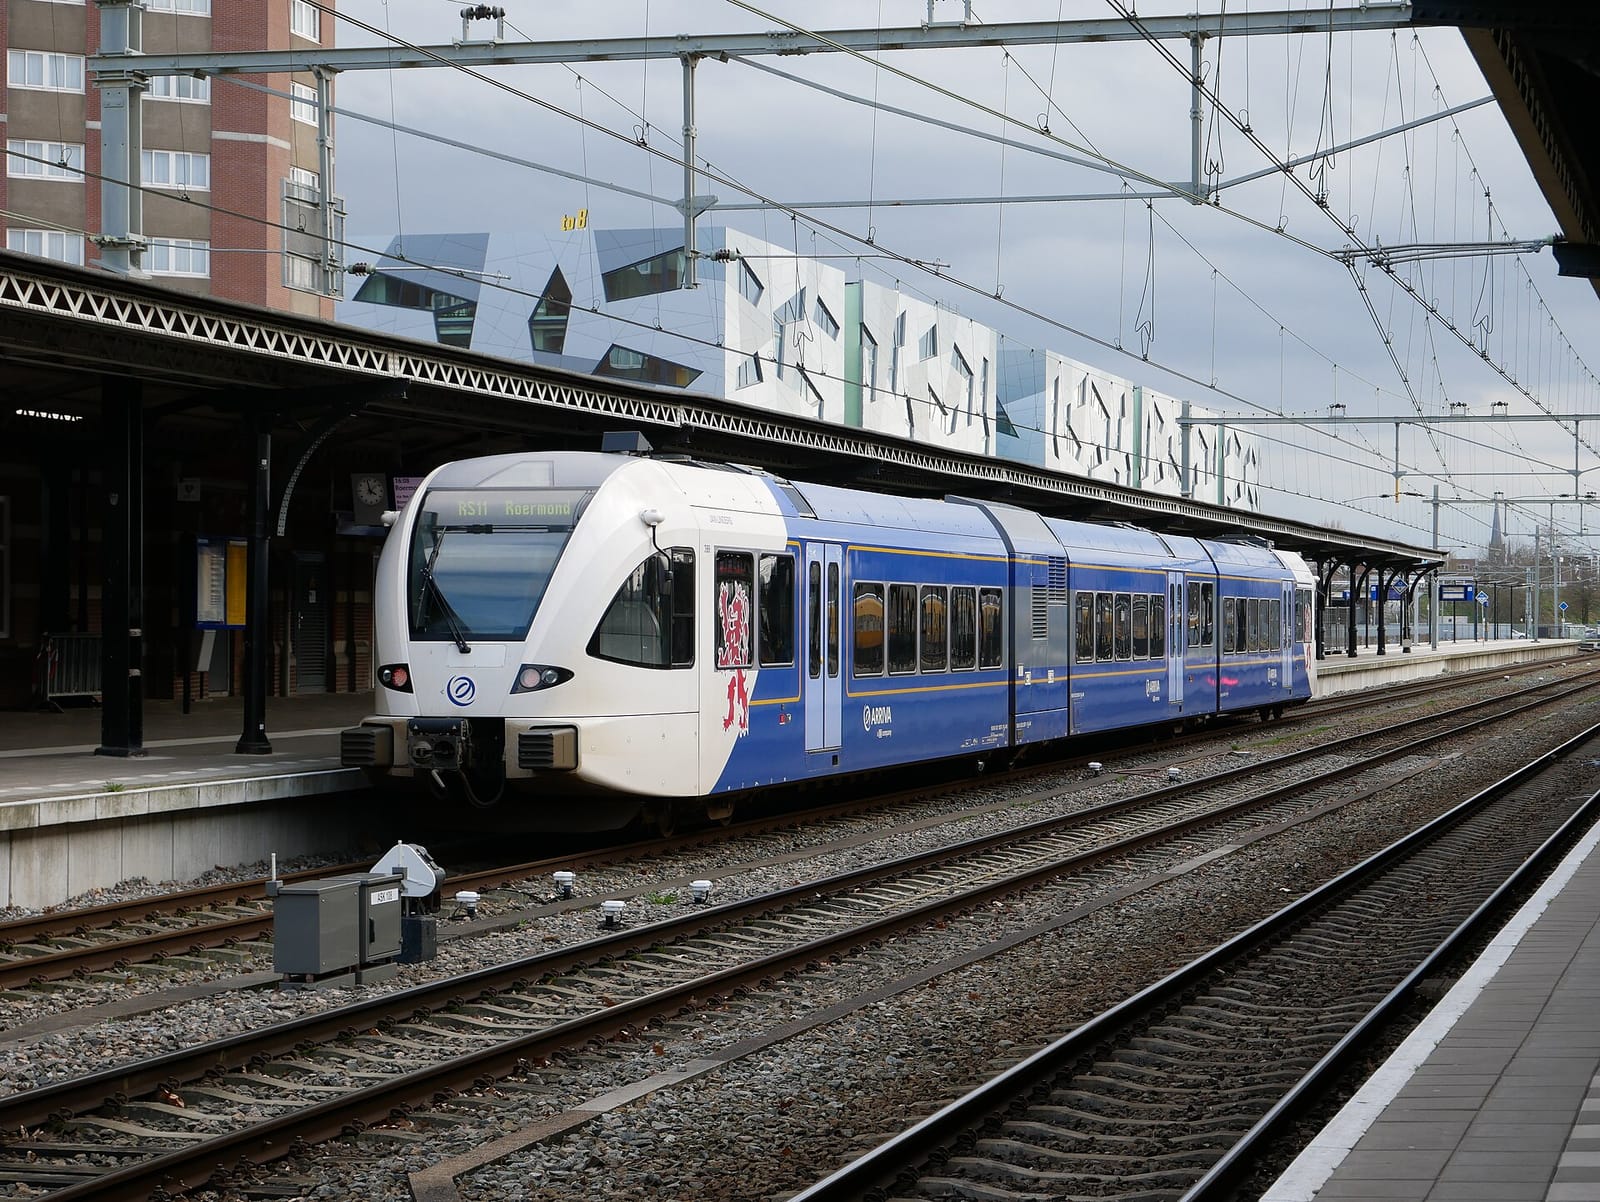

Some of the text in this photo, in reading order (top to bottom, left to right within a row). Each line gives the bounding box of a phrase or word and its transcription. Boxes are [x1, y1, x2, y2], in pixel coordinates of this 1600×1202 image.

[459, 500, 571, 516] RS11 Roermond
[871, 706, 892, 725] ARRIVA
